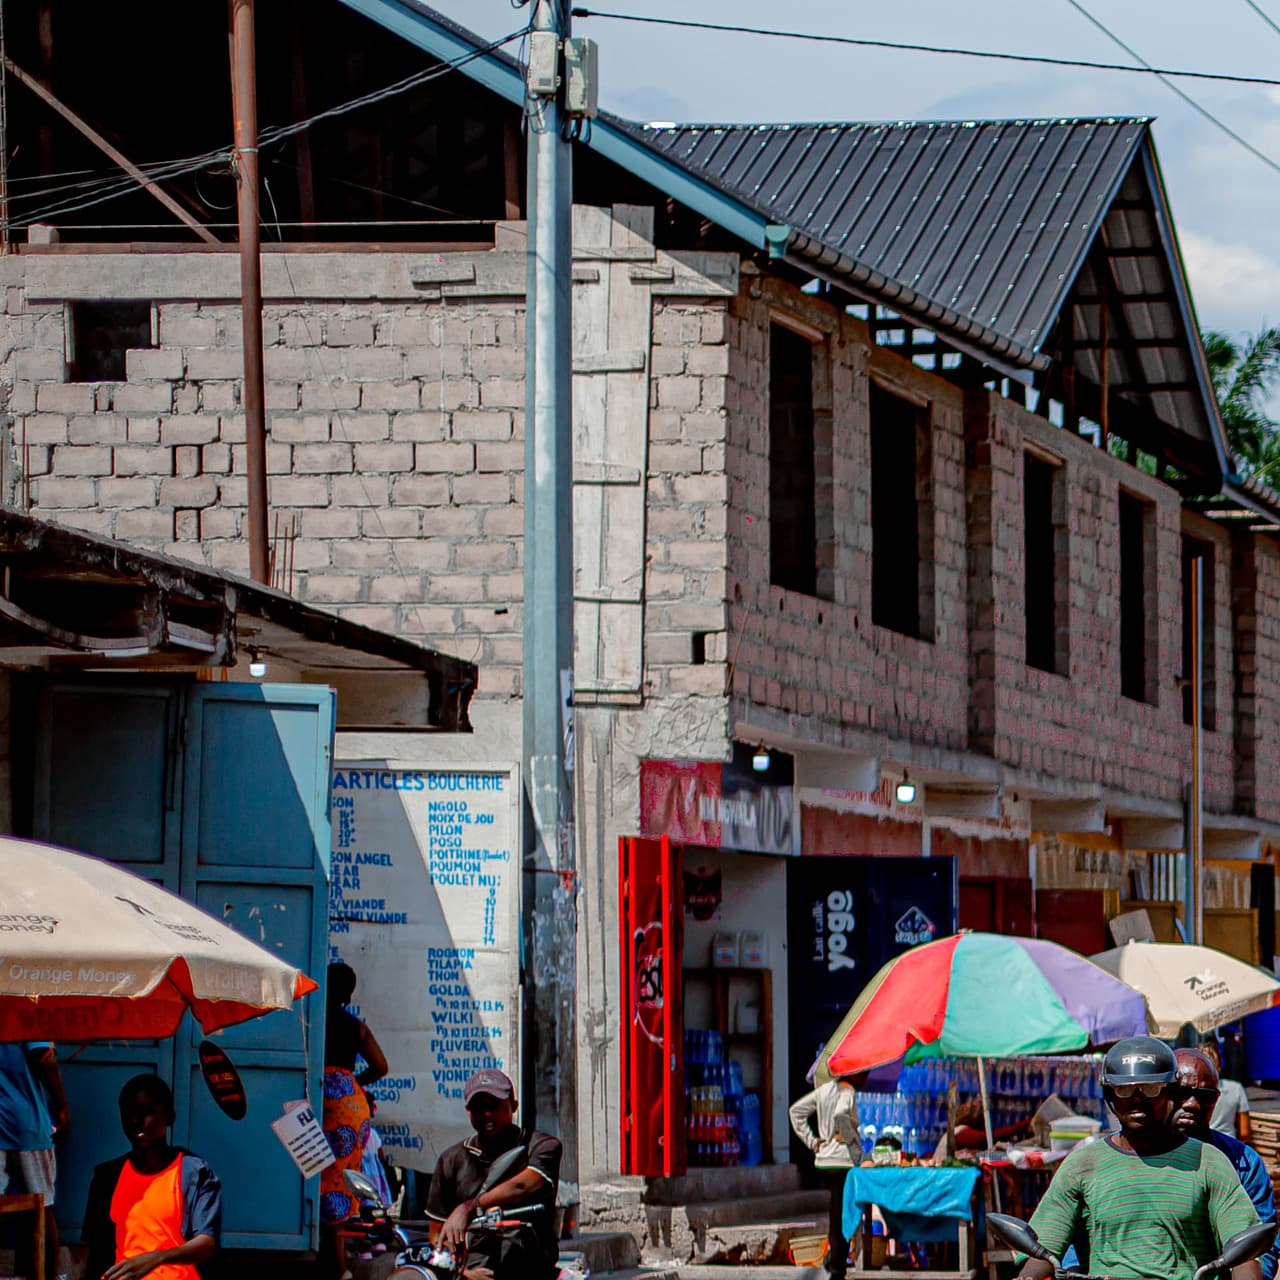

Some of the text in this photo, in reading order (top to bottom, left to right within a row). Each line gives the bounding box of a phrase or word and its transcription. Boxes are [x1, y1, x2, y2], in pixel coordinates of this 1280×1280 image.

[332, 772, 504, 791] ARTICLES BOUCHERIE
[428, 801, 467, 812] NGOLO
[428, 814, 456, 824] NOIX
[458, 814, 471, 824] DE
[428, 825, 463, 836] PILON
[429, 837, 462, 848] POSO
[355, 853, 393, 867] ANGEL
[429, 849, 481, 861] POITRINE
[429, 861, 481, 872] POUMON
[430, 873, 475, 886] POULET
[343, 899, 386, 911] VIANDE
[428, 948, 475, 959] ROGNON
[427, 959, 473, 970] TILAPIA
[9, 965, 136, 985] Orange Money
[428, 970, 459, 981] THON
[429, 985, 470, 997] GOLDA
[431, 1012, 473, 1024] WILKI
[430, 1040, 488, 1053] PLUVERA
